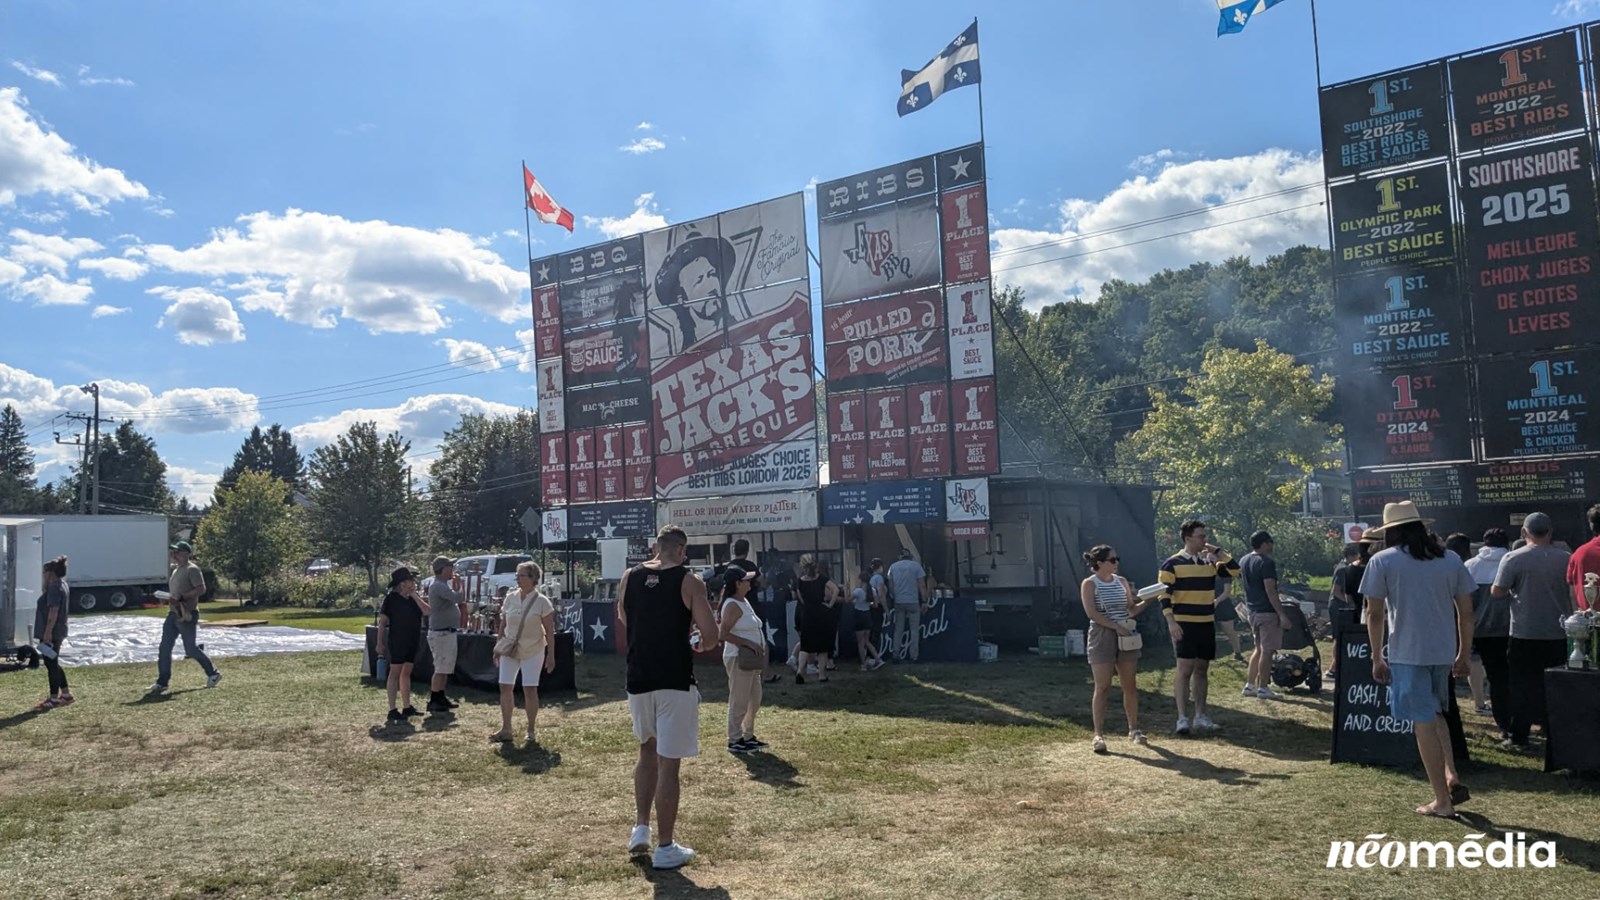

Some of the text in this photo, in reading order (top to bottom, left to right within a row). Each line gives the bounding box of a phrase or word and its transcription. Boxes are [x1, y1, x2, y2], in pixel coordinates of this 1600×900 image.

[1476, 79, 1556, 105] MONTREAL
[1493, 95, 1542, 115] 2022
[1344, 108, 1424, 133] SOUTHSHORE
[1471, 103, 1569, 136] BEST RIBS
[1363, 122, 1405, 139] 2022
[1341, 129, 1428, 156] BEST RIBS &
[1342, 140, 1430, 167] BEST SAUCE
[1469, 147, 1580, 188] SOUTHSHORE
[829, 167, 924, 208] RIBS
[955, 192, 980, 228] 1ST
[1482, 184, 1570, 226] 2025
[1340, 204, 1442, 232] OLYMPIC PARK
[946, 226, 984, 241] PLACE
[1371, 222, 1415, 239] 2022
[757, 235, 795, 269] Famous
[849, 224, 890, 272] TEXAS
[1343, 231, 1445, 261] BEST SAUCE
[1487, 231, 1578, 260] MEILLEURE
[571, 246, 627, 273] BBQ
[761, 240, 800, 281] Original
[1360, 250, 1428, 267] PEOPLE'S CHOICE
[880, 253, 913, 282] BBQ
[1480, 256, 1591, 287] CHOIX JUGES
[1522, 284, 1578, 307] COTES
[961, 289, 984, 324] 1ST
[536, 318, 559, 328] PLACE
[843, 307, 912, 341] PULLED
[1363, 307, 1435, 325] MONTREAL
[1508, 312, 1571, 334] LEVEES
[951, 324, 989, 336] PLACE
[1379, 322, 1421, 336] 2022
[847, 326, 923, 373] PORK
[1353, 332, 1450, 355] BEST SAUCE
[586, 345, 623, 366] SAUCE
[964, 348, 979, 357] BEST
[1411, 350, 1438, 360] CHOICE
[651, 317, 801, 418] TEXAS
[582, 404, 598, 413] MAC
[611, 398, 639, 408] CHEESE
[919, 390, 942, 423] 1ST
[965, 386, 989, 420] 1ST
[1506, 394, 1587, 411] MONTREAL
[840, 400, 860, 431] 1ST
[879, 396, 900, 428] 1ST
[1377, 408, 1440, 423] OTTAWA
[1524, 409, 1570, 424] 2024
[870, 429, 905, 439] PLACE
[910, 423, 947, 434] PLACE
[955, 420, 994, 432] PLACE
[1388, 422, 1429, 435] 2024
[1521, 423, 1578, 436] BEST SAUCE
[831, 432, 865, 442] PLACE
[1525, 435, 1575, 448] & CHICKEN
[881, 452, 894, 460] BEST
[1400, 444, 1431, 454] SAUCE
[1556, 444, 1589, 452] CHOICE
[597, 459, 621, 468] PLACE
[625, 456, 651, 465] PLACE
[773, 449, 811, 466] CHOICE
[842, 454, 855, 462] BEST
[872, 458, 906, 468] PULLED PORK
[921, 454, 939, 463] SAUCE
[967, 454, 986, 463] SAUCE
[542, 464, 565, 472] PLACE
[570, 462, 594, 471] PLACE
[1489, 463, 1560, 475] COMBOS
[688, 465, 811, 488] BEST RIBS LONDON 2025
[1500, 474, 1537, 482] CHICKEN
[1501, 490, 1534, 498] DELIGHT
[673, 508, 692, 518] HELL
[695, 506, 706, 516] OR
[708, 506, 728, 516] HIGH
[731, 504, 761, 514] WATER
[1346, 643, 1368, 658] WE
[1347, 684, 1381, 708] CASH,
[1343, 713, 1415, 734] AND CREDI
